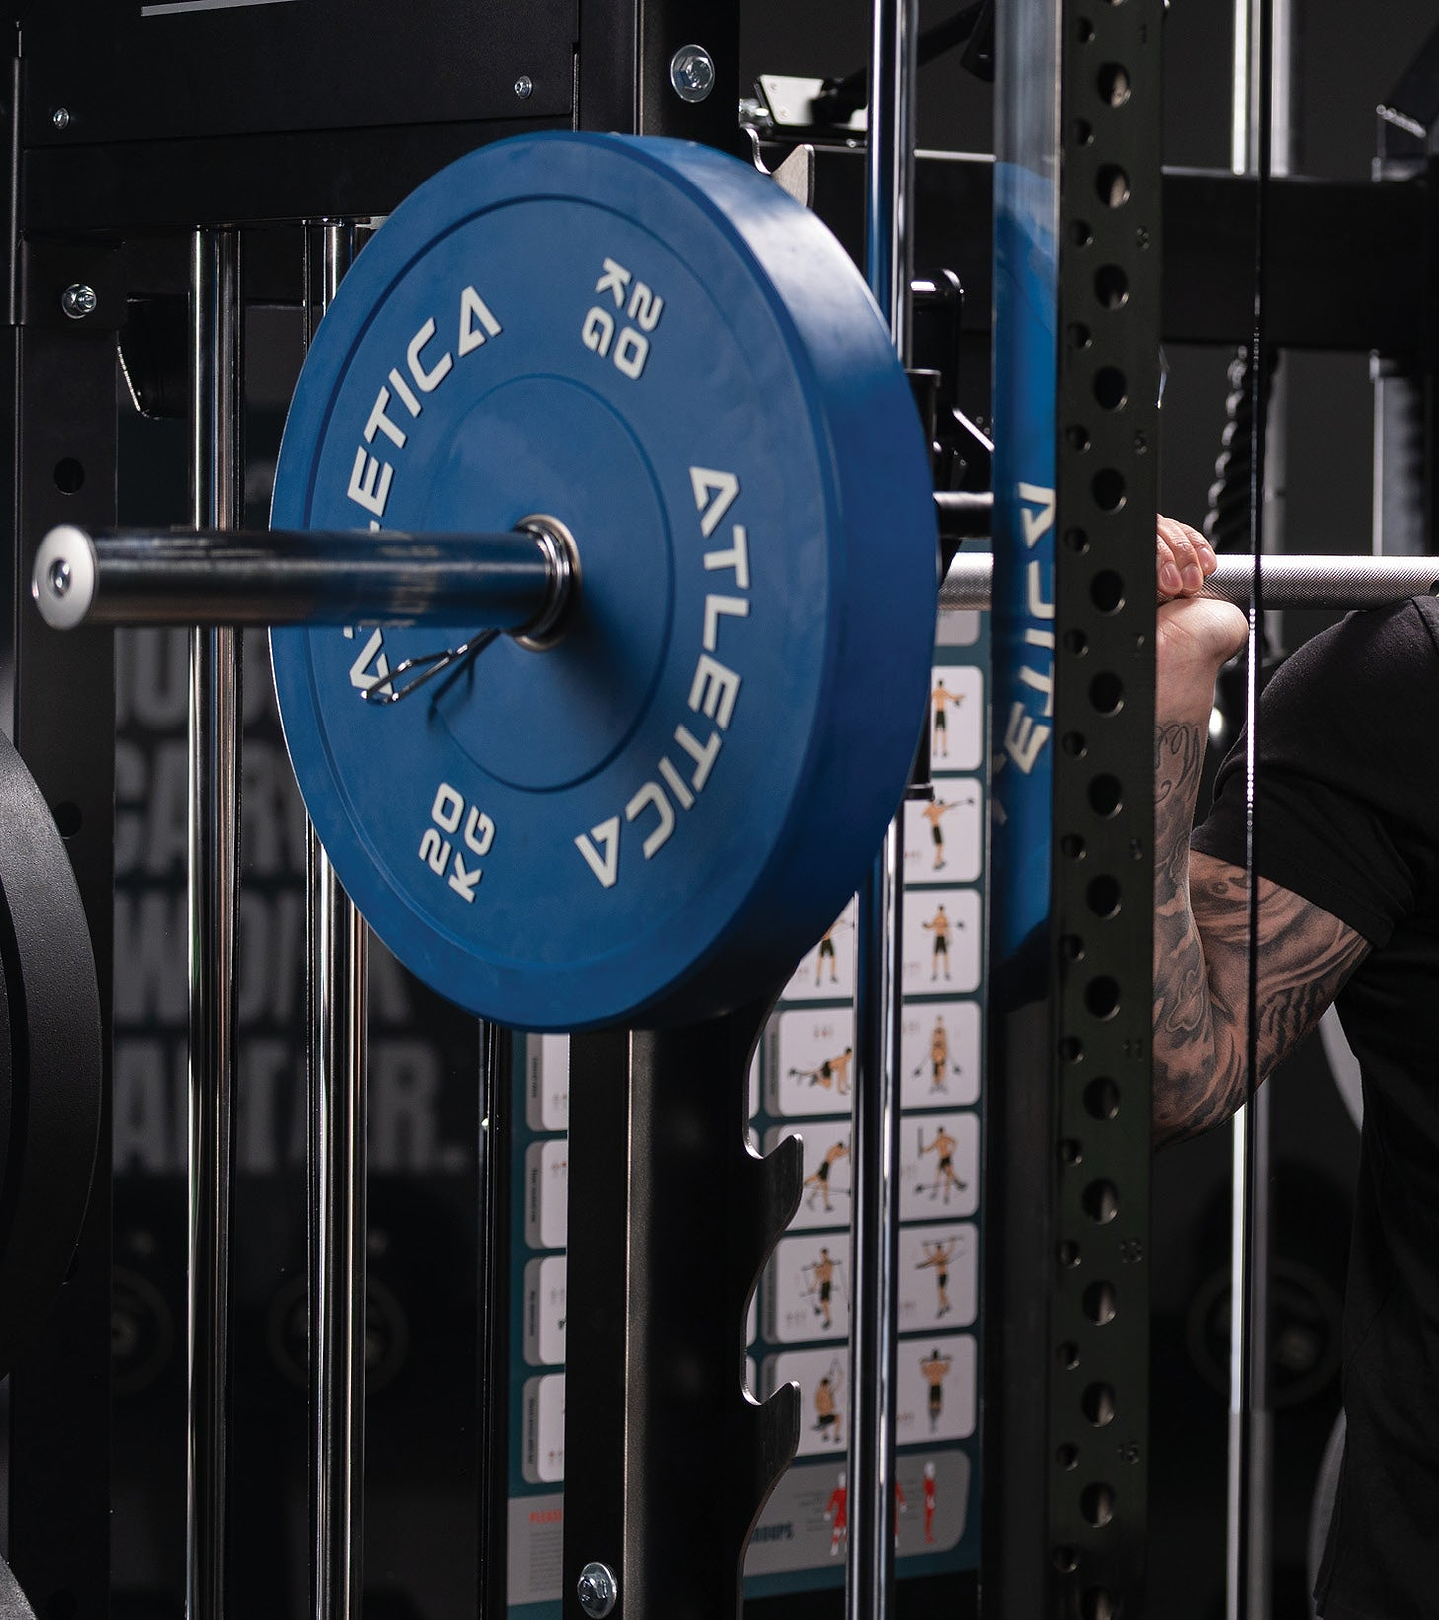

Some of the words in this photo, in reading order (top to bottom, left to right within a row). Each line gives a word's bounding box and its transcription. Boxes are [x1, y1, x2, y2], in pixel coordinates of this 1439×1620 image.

[581, 257, 632, 357] KG
[612, 284, 664, 380] 20
[343, 285, 503, 698] AETICA
[574, 465, 751, 889] ATLETICA
[419, 782, 464, 880] 20
[447, 803, 497, 903] KG
